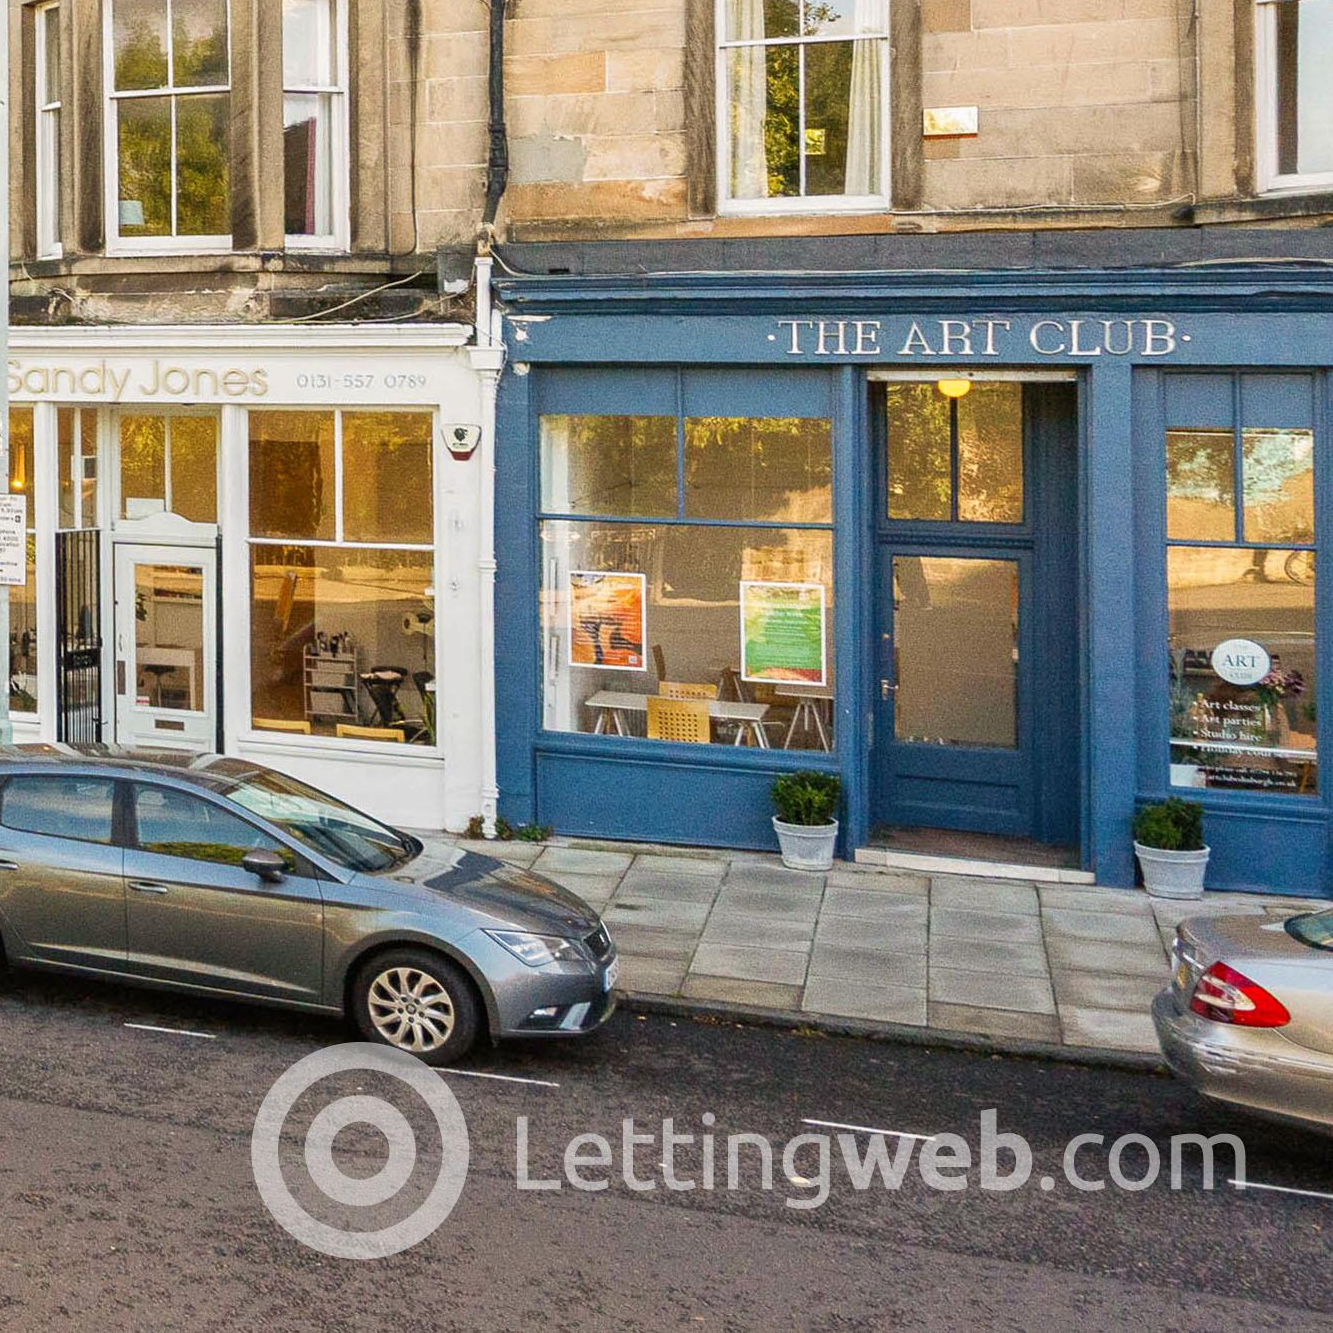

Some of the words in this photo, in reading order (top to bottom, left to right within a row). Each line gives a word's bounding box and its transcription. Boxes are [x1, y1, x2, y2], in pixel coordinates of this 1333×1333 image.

[778, 319, 880, 355] THE
[897, 319, 1010, 355] ART
[1029, 319, 1176, 355] CLUB
[138, 360, 269, 396] Jones
[1222, 653, 1260, 668] ART
[1222, 700, 1261, 713] classes
[1222, 715, 1262, 728] parties
[1200, 728, 1237, 741] Studio
[1239, 729, 1263, 742] hire
